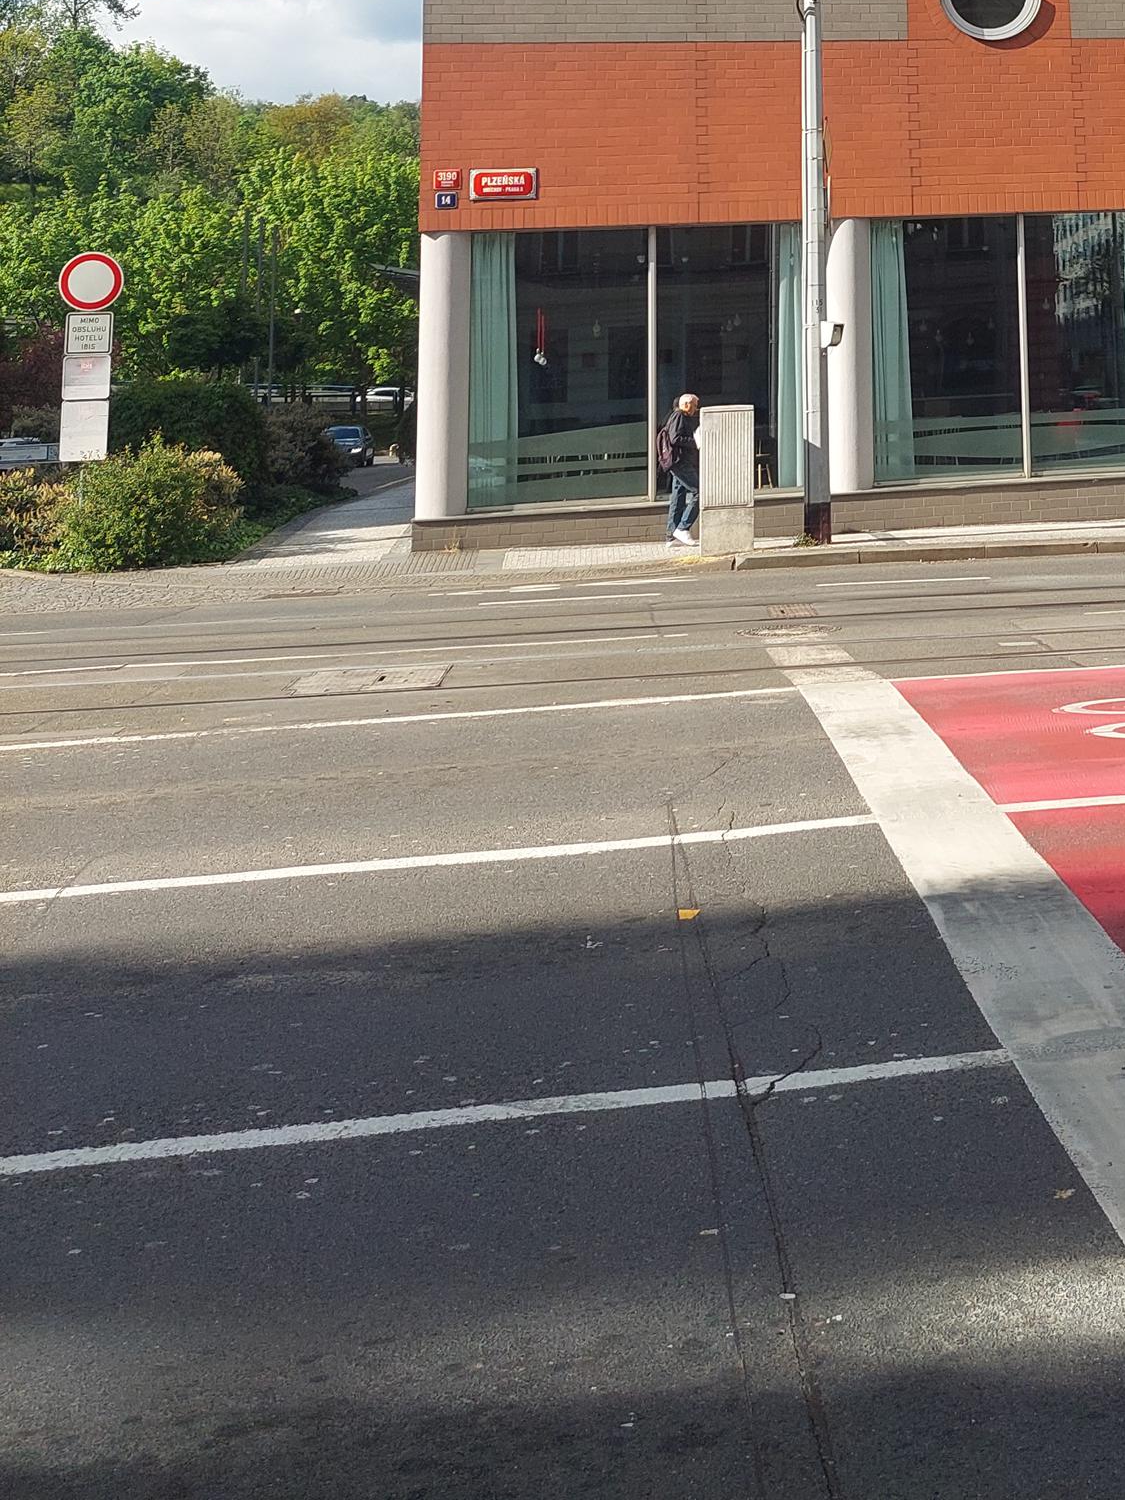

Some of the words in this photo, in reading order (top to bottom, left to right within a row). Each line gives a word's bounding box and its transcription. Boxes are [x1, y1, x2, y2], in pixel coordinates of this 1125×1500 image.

[437, 172, 457, 181] 3190
[481, 174, 525, 186] PLZEŇSKÁ
[441, 195, 451, 205] 14
[74, 334, 104, 342] HOTELU
